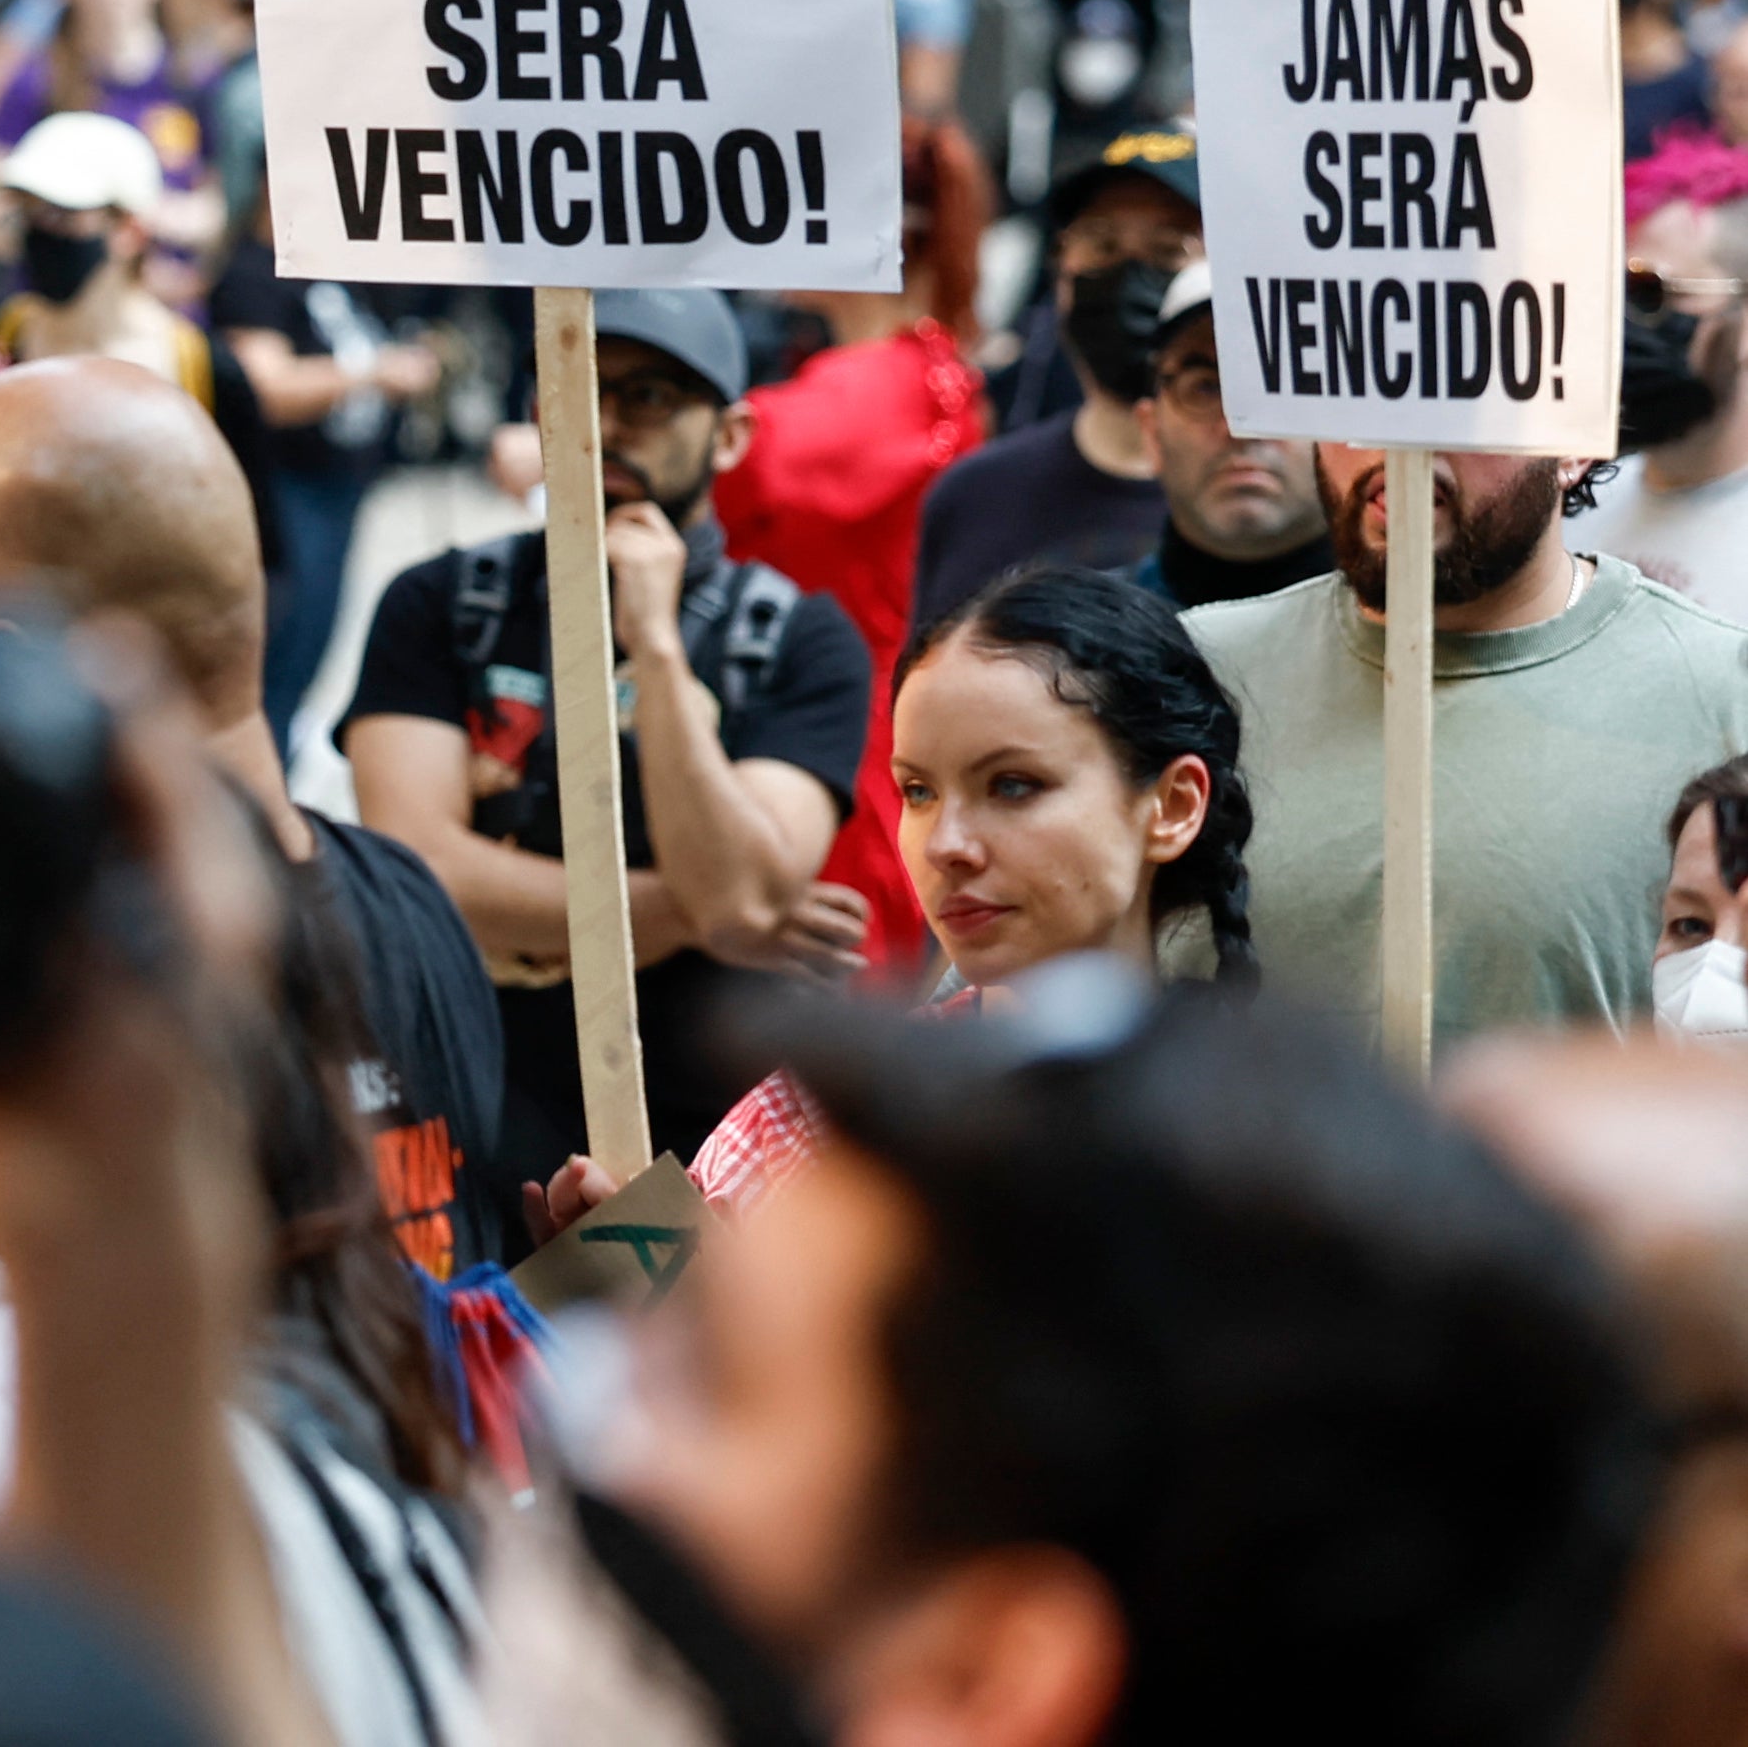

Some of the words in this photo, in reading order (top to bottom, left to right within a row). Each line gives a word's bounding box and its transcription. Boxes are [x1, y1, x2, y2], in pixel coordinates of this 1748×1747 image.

[324, 126, 829, 248] VENCIDO!
[1304, 98, 1497, 251] SERÁ
[1244, 276, 1566, 402] VENCIDO!
